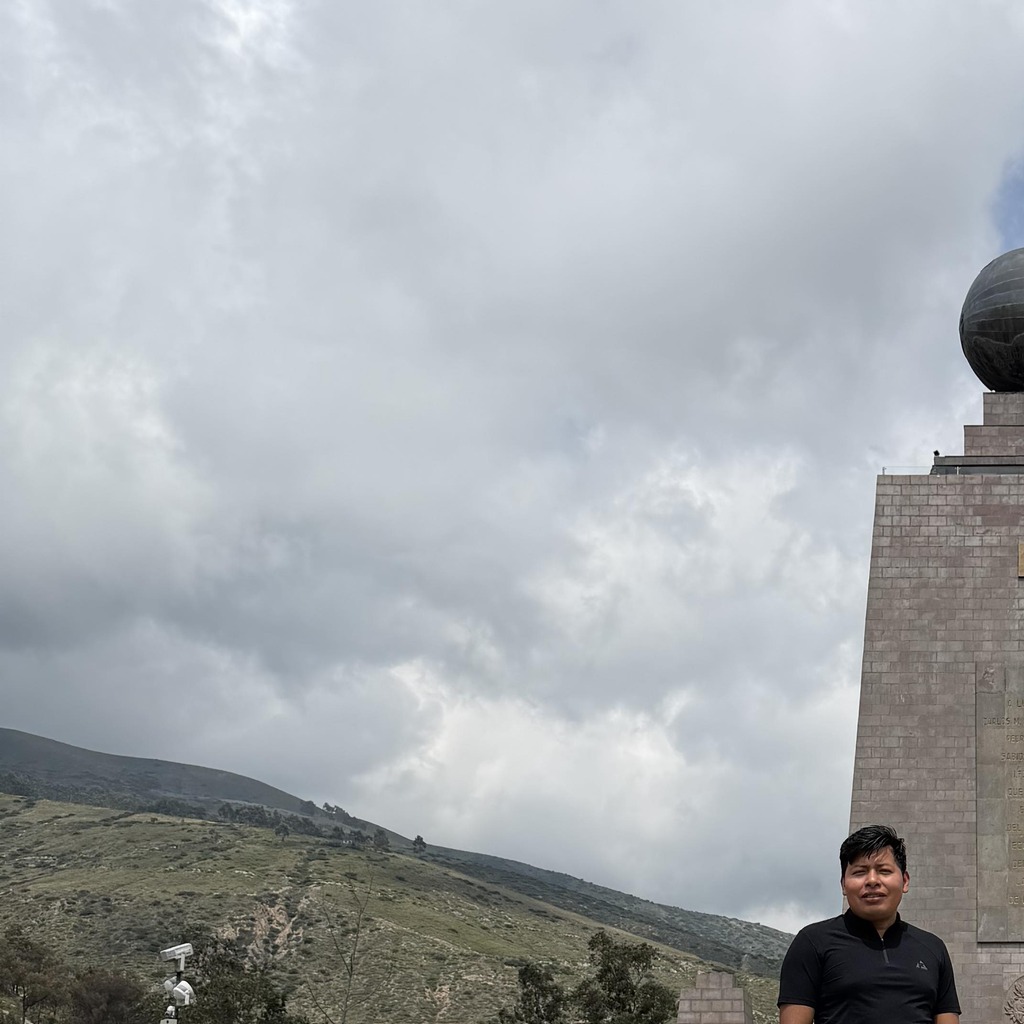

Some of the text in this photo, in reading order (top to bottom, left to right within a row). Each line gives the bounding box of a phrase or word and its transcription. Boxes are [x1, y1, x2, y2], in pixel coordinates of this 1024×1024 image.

[983, 717, 1010, 726] CARLOS
[1007, 787, 1024, 797] QUE
[1006, 823, 1021, 833] DEL
[1008, 896, 1019, 905] DE
